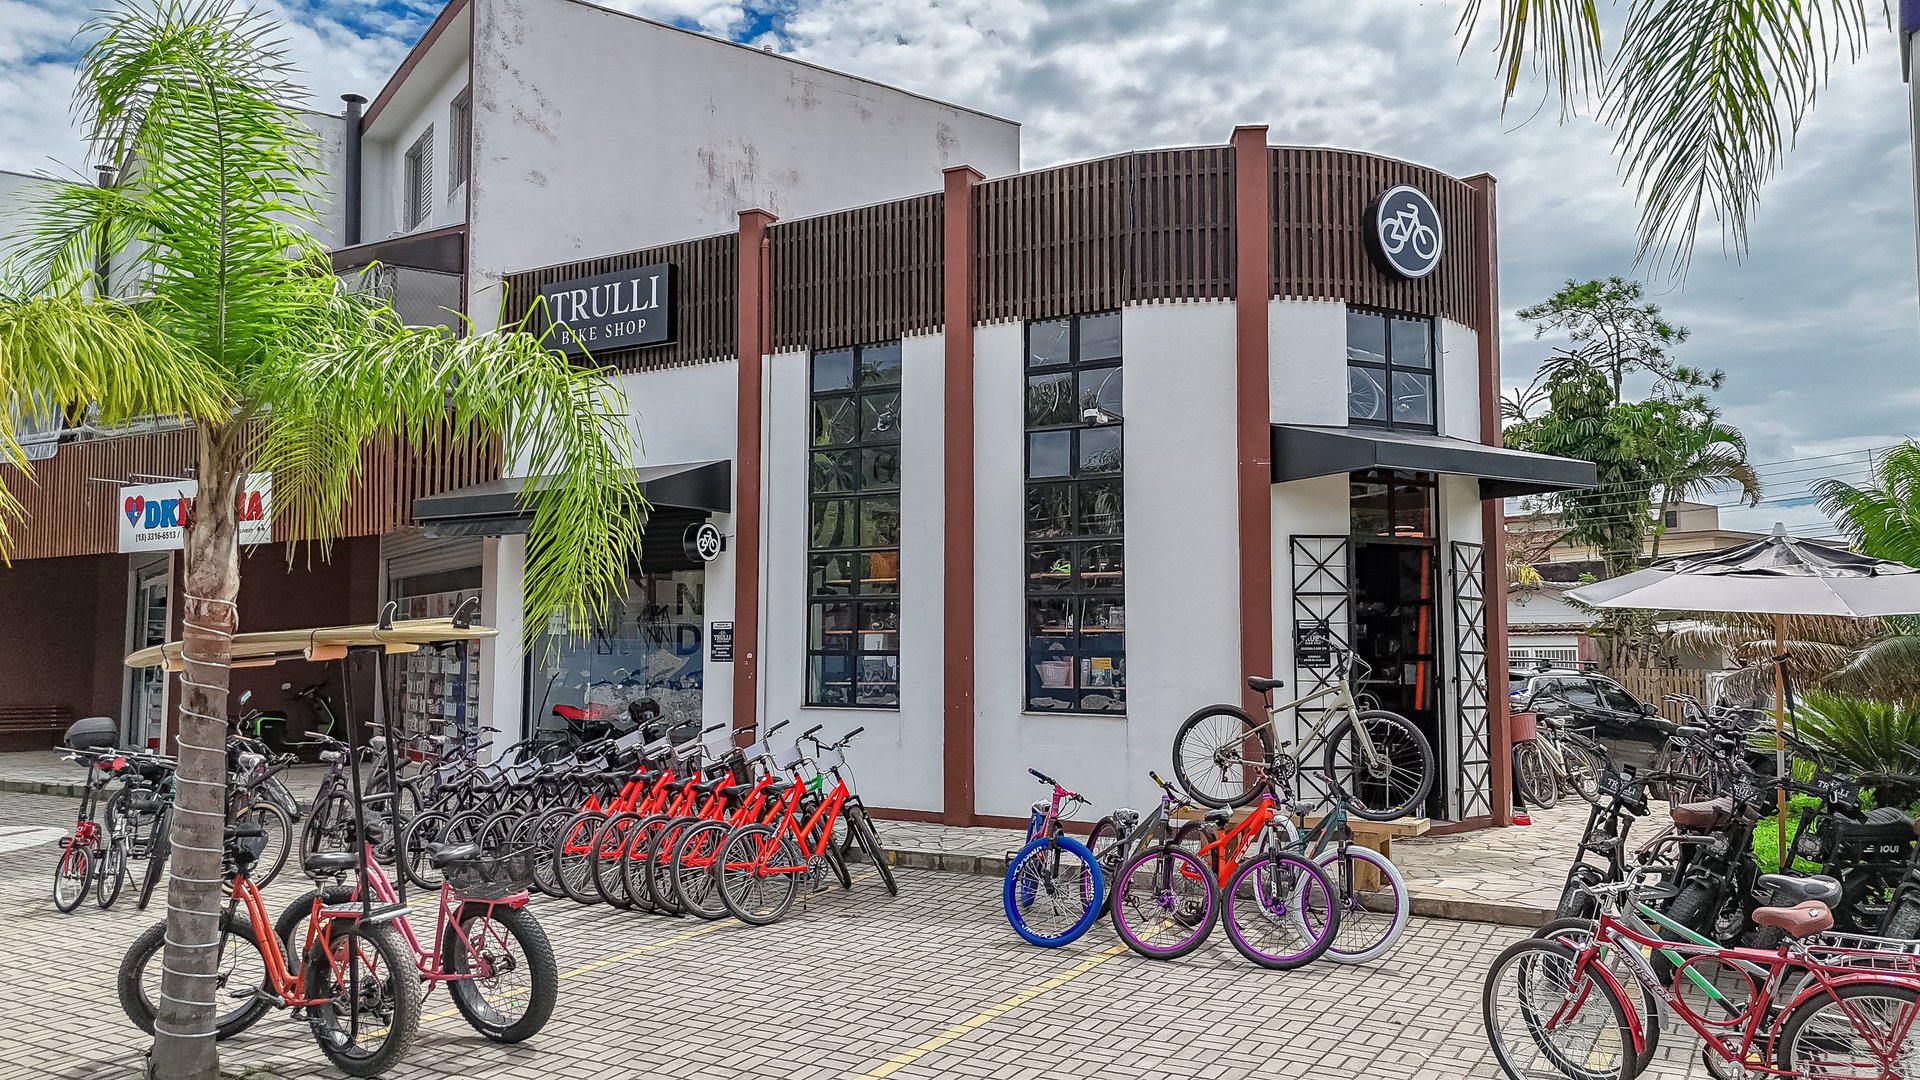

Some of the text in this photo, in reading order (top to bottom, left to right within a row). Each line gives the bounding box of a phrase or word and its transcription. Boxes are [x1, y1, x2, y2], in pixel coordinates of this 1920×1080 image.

[550, 275, 660, 324] TRULLI
[562, 318, 647, 345] BIKE SHOP
[135, 533, 147, 543] (13)
